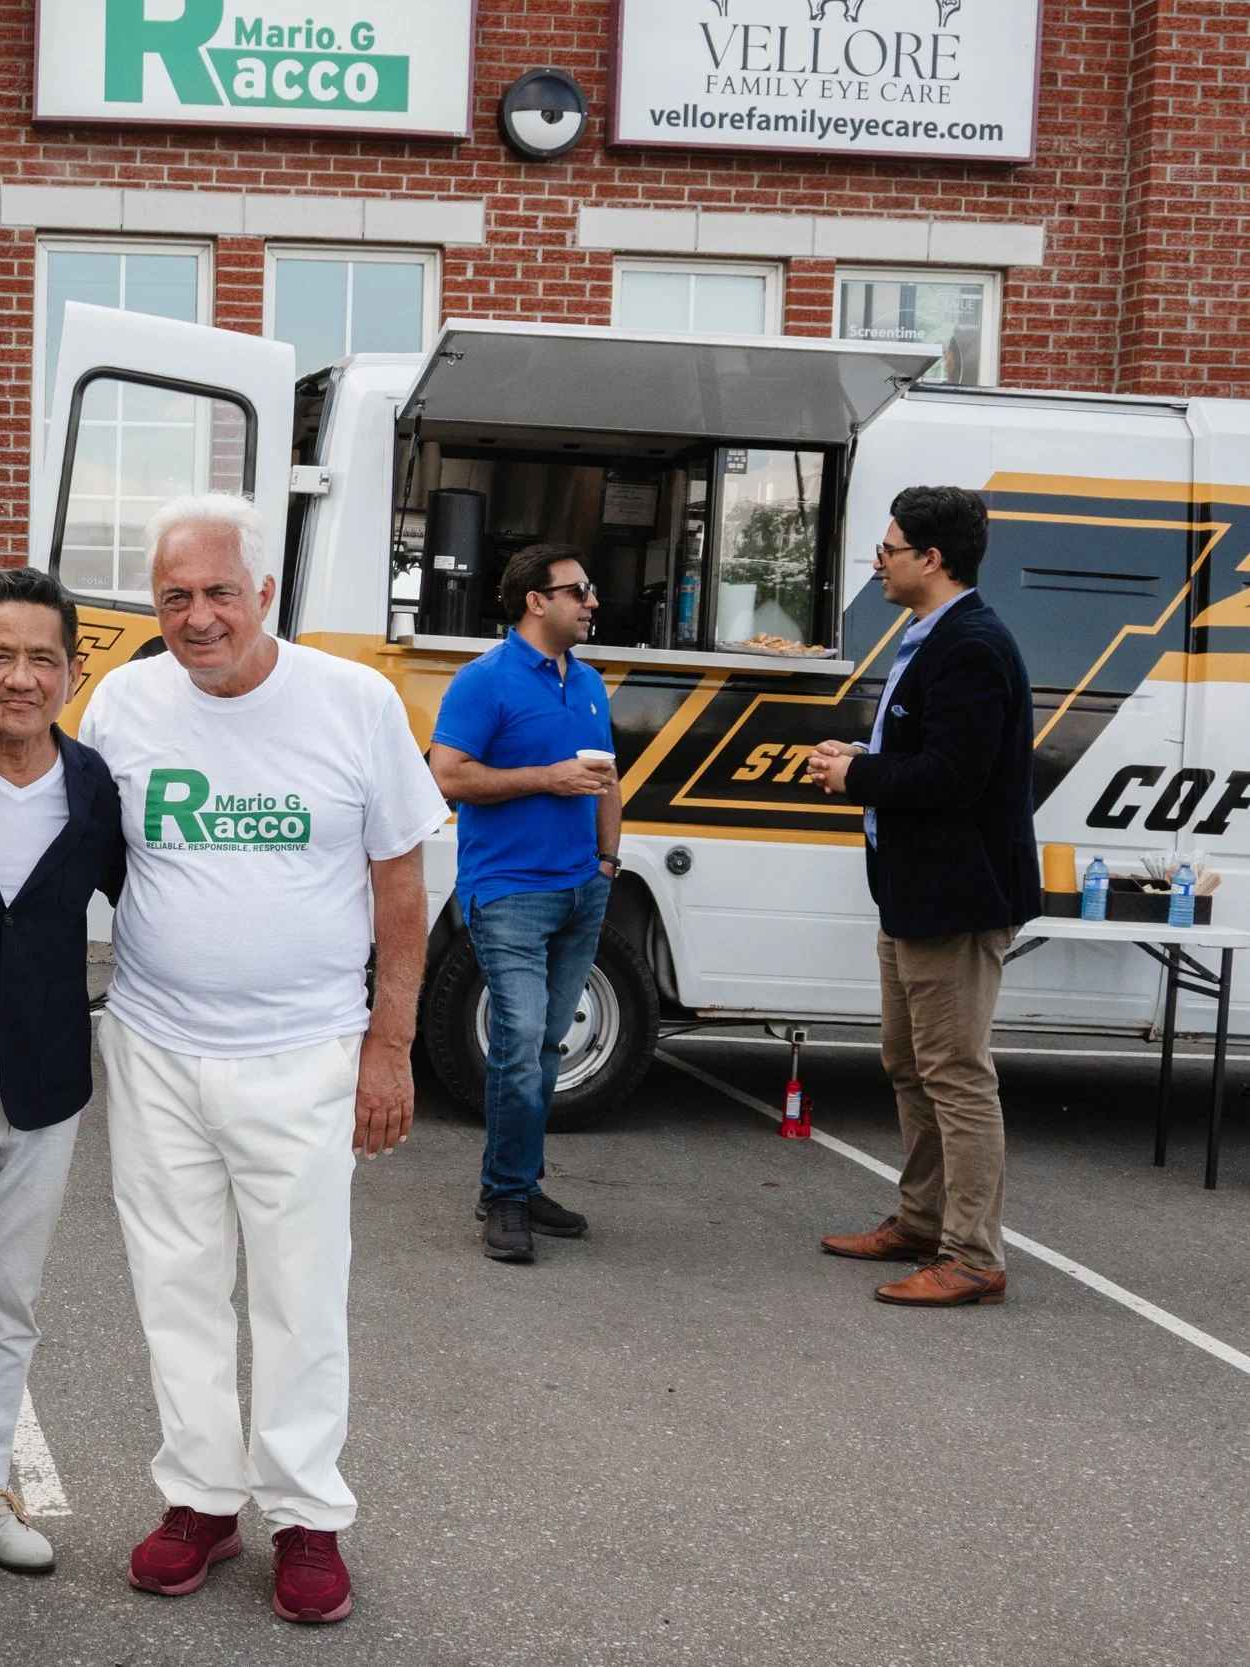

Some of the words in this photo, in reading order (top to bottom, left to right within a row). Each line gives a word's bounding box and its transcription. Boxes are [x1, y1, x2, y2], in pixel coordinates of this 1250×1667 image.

[698, 22, 961, 81] VELLORE
[705, 74, 810, 98] FAMILY
[820, 79, 871, 101] EYE
[880, 82, 952, 105] CARE
[650, 103, 1004, 141] vellorefamilyeyecare.com
[849, 325, 927, 339] Screentime
[215, 793, 277, 812] Mario
[284, 794, 308, 812] G.
[146, 841, 186, 851] RELIABLE.
[188, 843, 251, 852] RESPONSIBLE.
[252, 843, 309, 852] RESPONSIVE.
